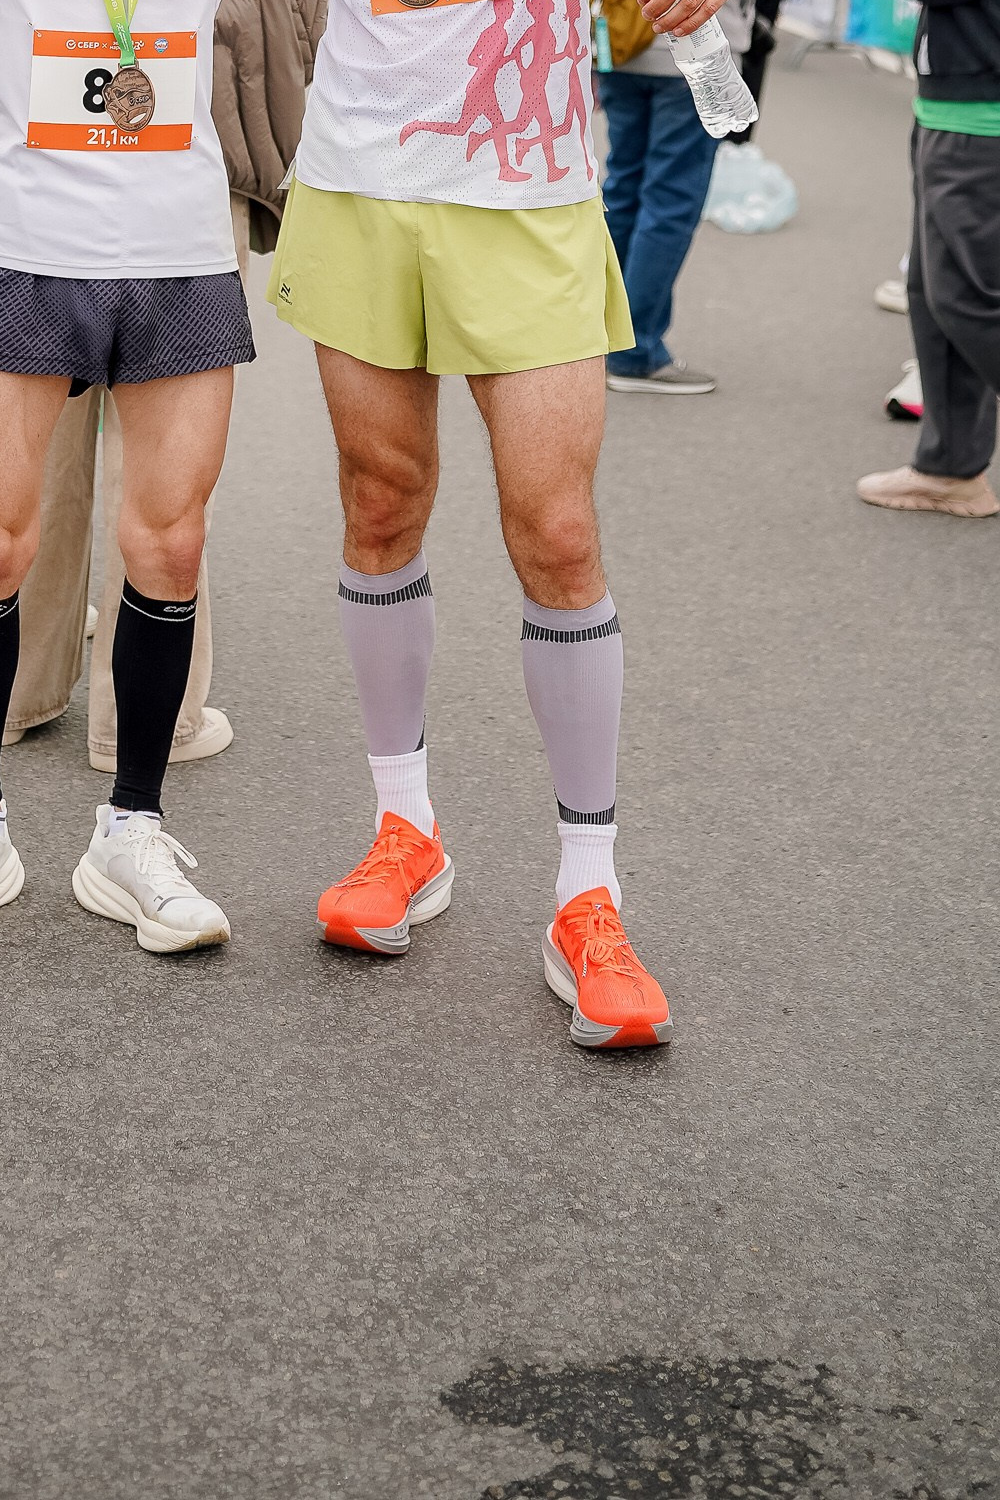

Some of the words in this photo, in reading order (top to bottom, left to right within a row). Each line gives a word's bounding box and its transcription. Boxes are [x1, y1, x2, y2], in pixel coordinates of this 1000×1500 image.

[77, 41, 100, 49] СБЕР
[87, 129, 118, 148] 21,1
[120, 136, 139, 145] км
[163, 603, 197, 614] CRA
